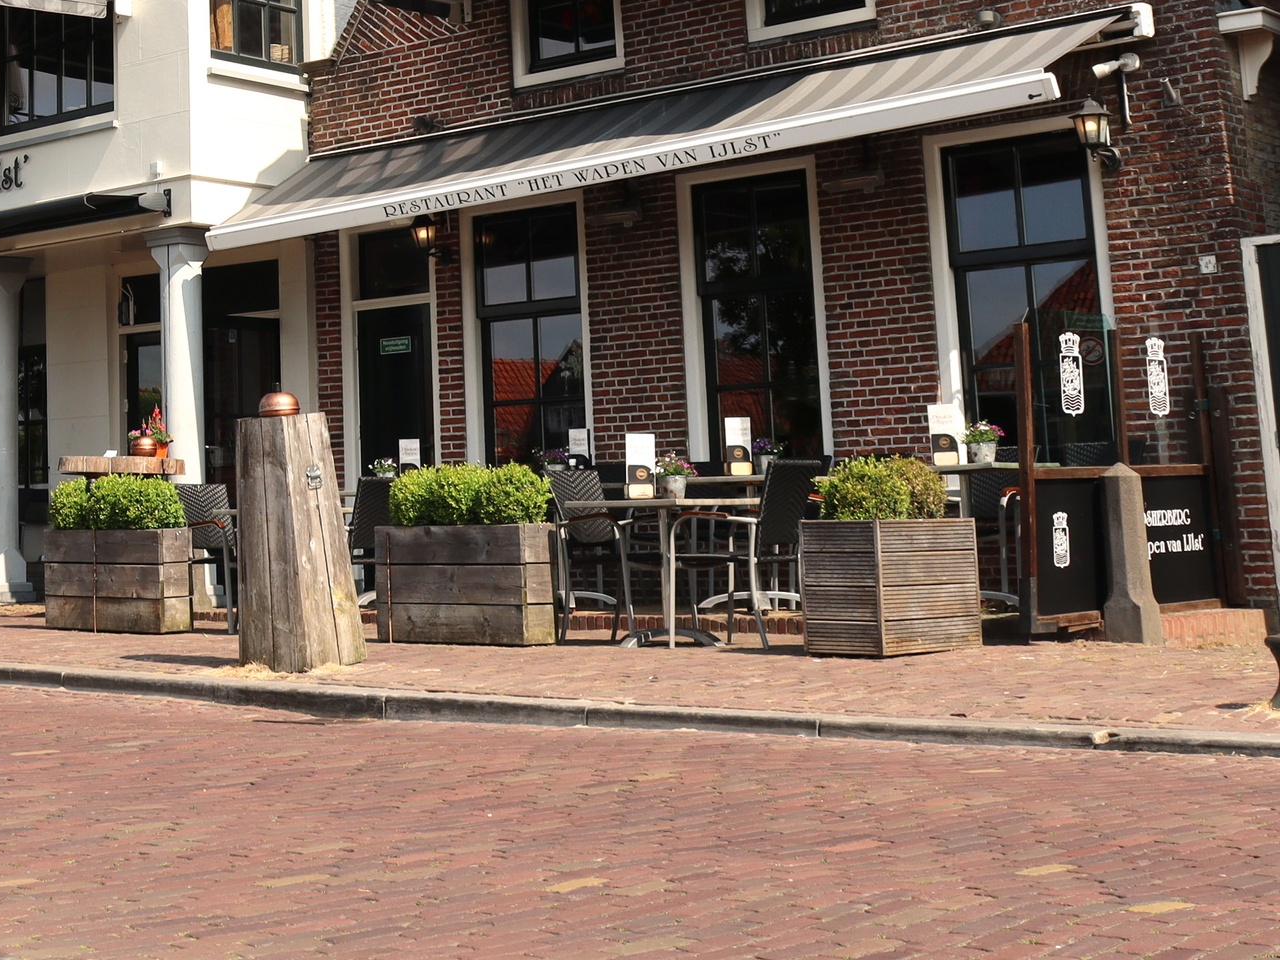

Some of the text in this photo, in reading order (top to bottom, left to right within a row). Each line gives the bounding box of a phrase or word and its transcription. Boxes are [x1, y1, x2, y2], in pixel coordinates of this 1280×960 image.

[382, 183, 508, 218] RESTAURANT
[517, 173, 563, 193] "HET
[571, 158, 647, 183] WAPEN
[656, 148, 698, 168] VAN
[1143, 508, 1191, 527] SHERBERG
[1147, 540, 1166, 560] pen
[1166, 539, 1182, 553] van
